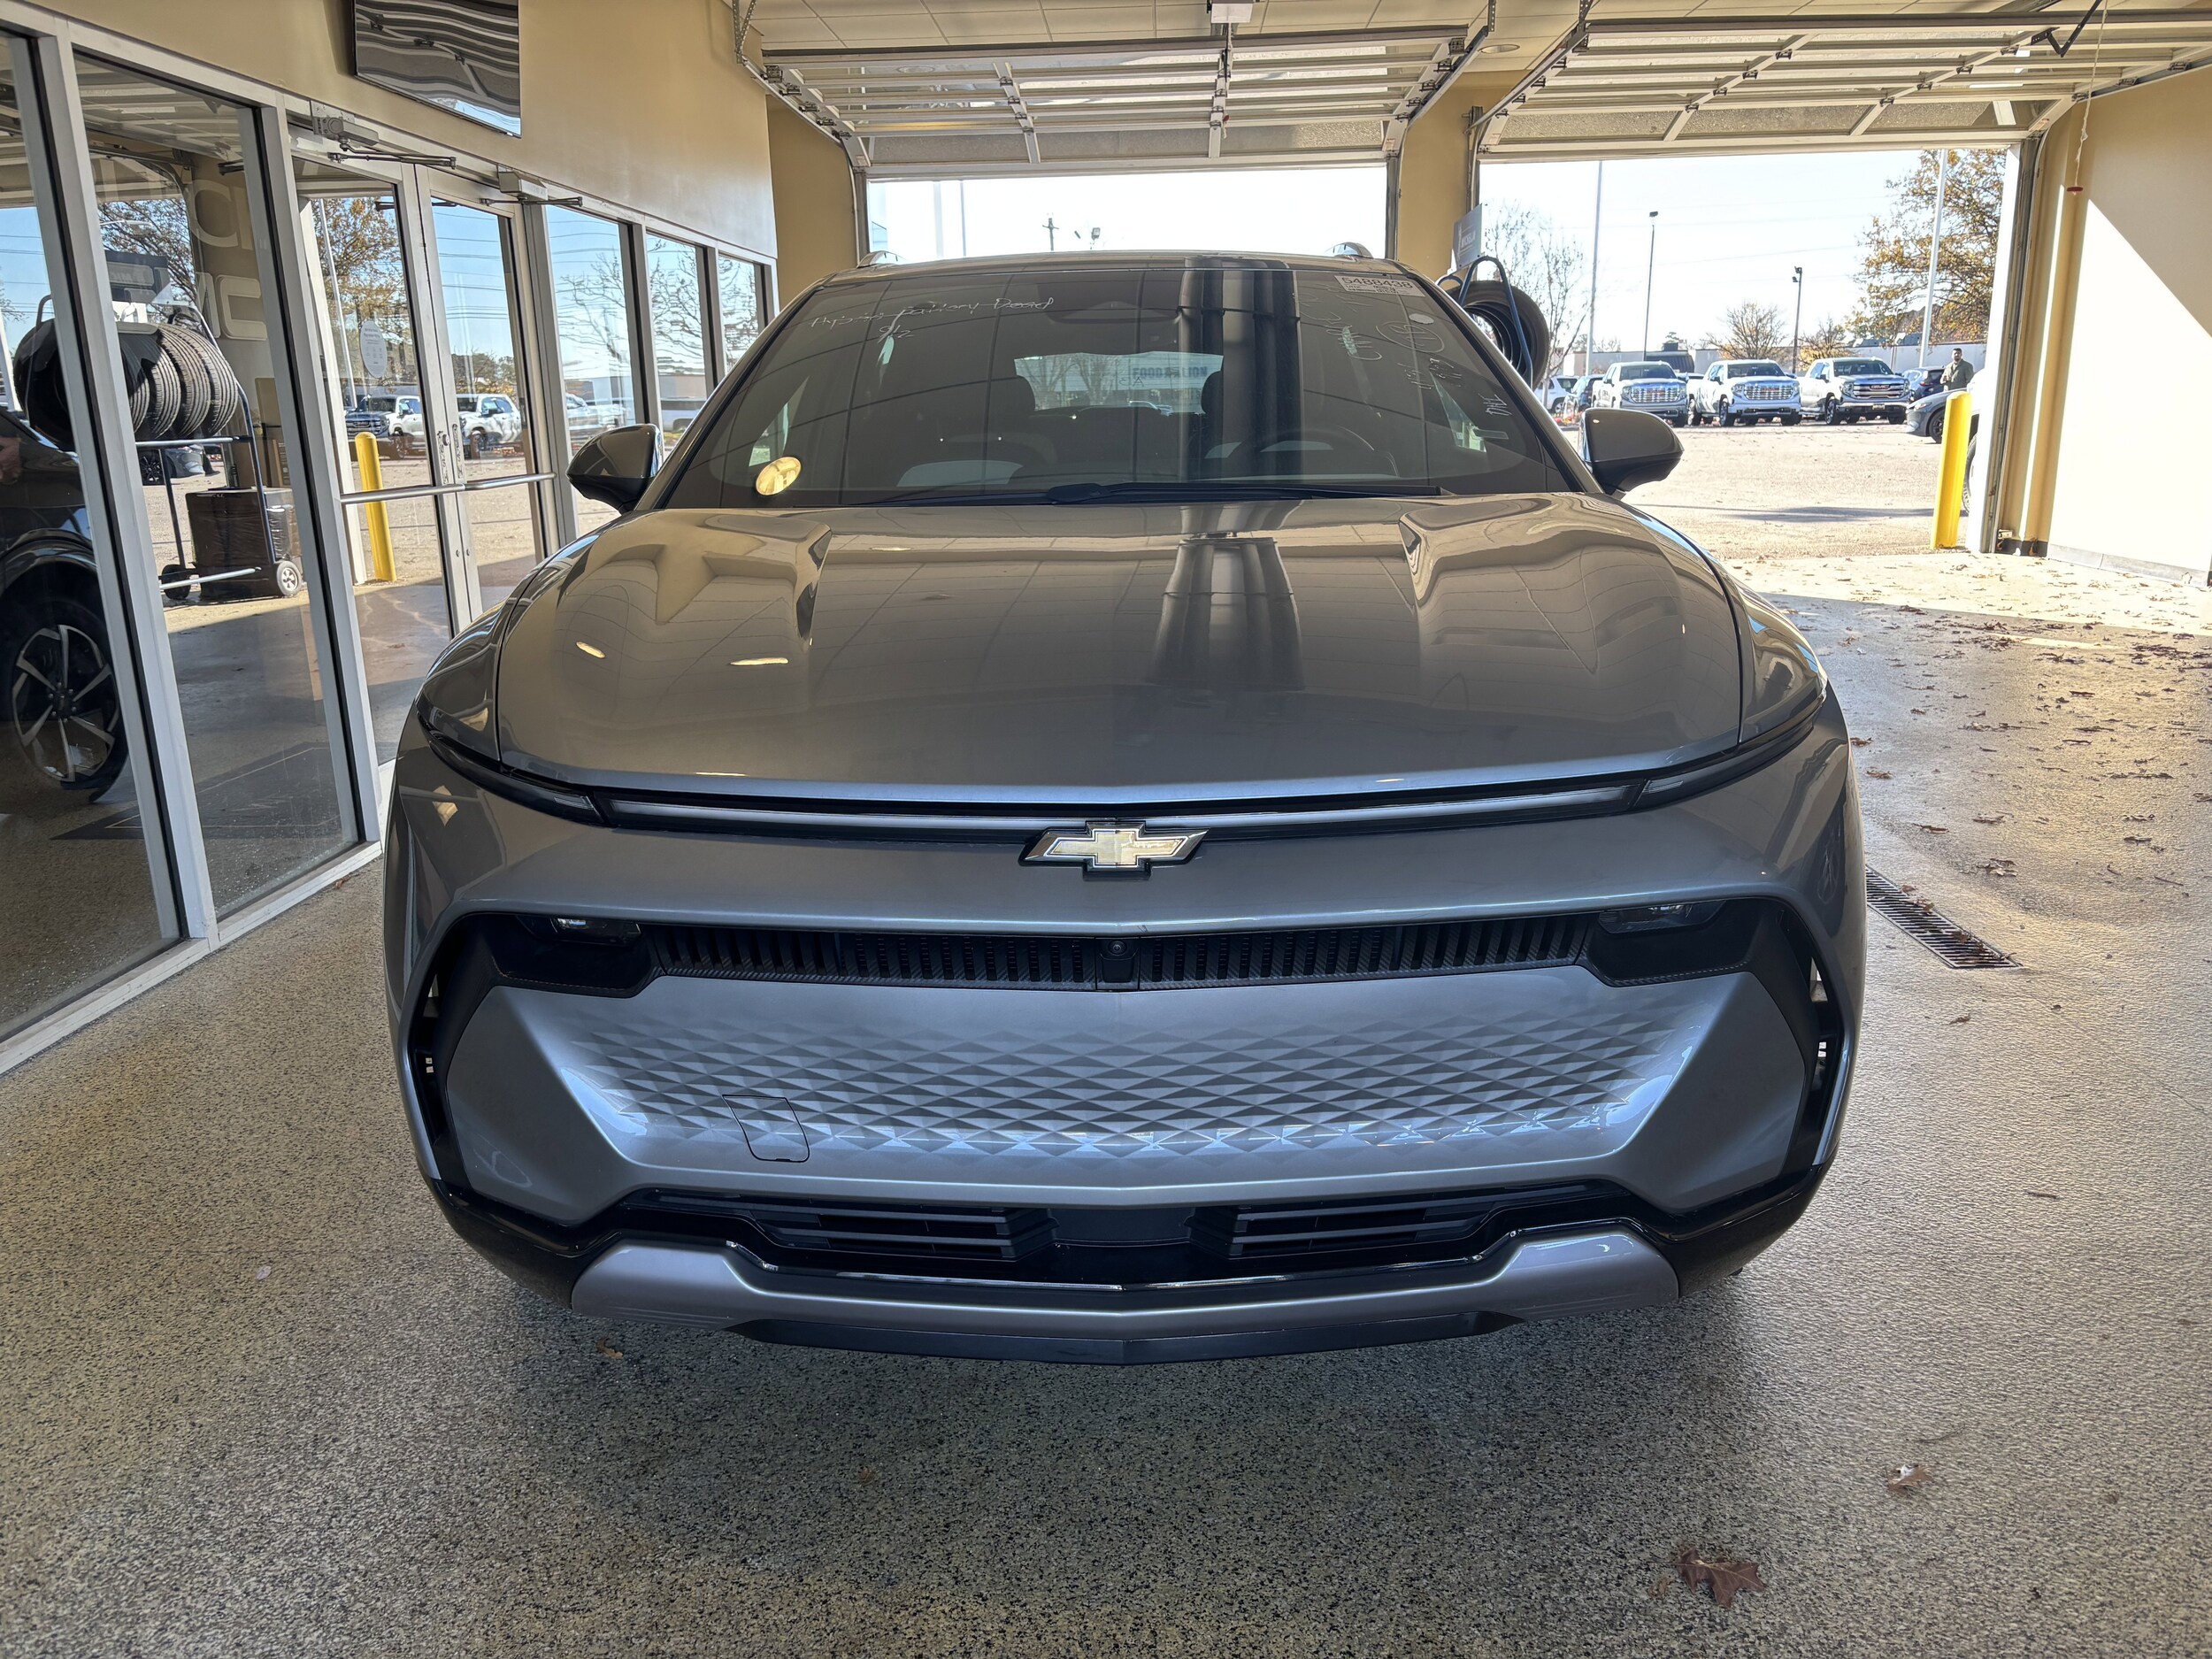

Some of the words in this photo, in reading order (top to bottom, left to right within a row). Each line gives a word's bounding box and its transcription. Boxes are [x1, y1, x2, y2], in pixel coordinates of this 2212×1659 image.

[1341, 277, 1413, 288] 5488438
[1133, 367, 1163, 378] FOOD
[1182, 366, 1208, 377] LION
